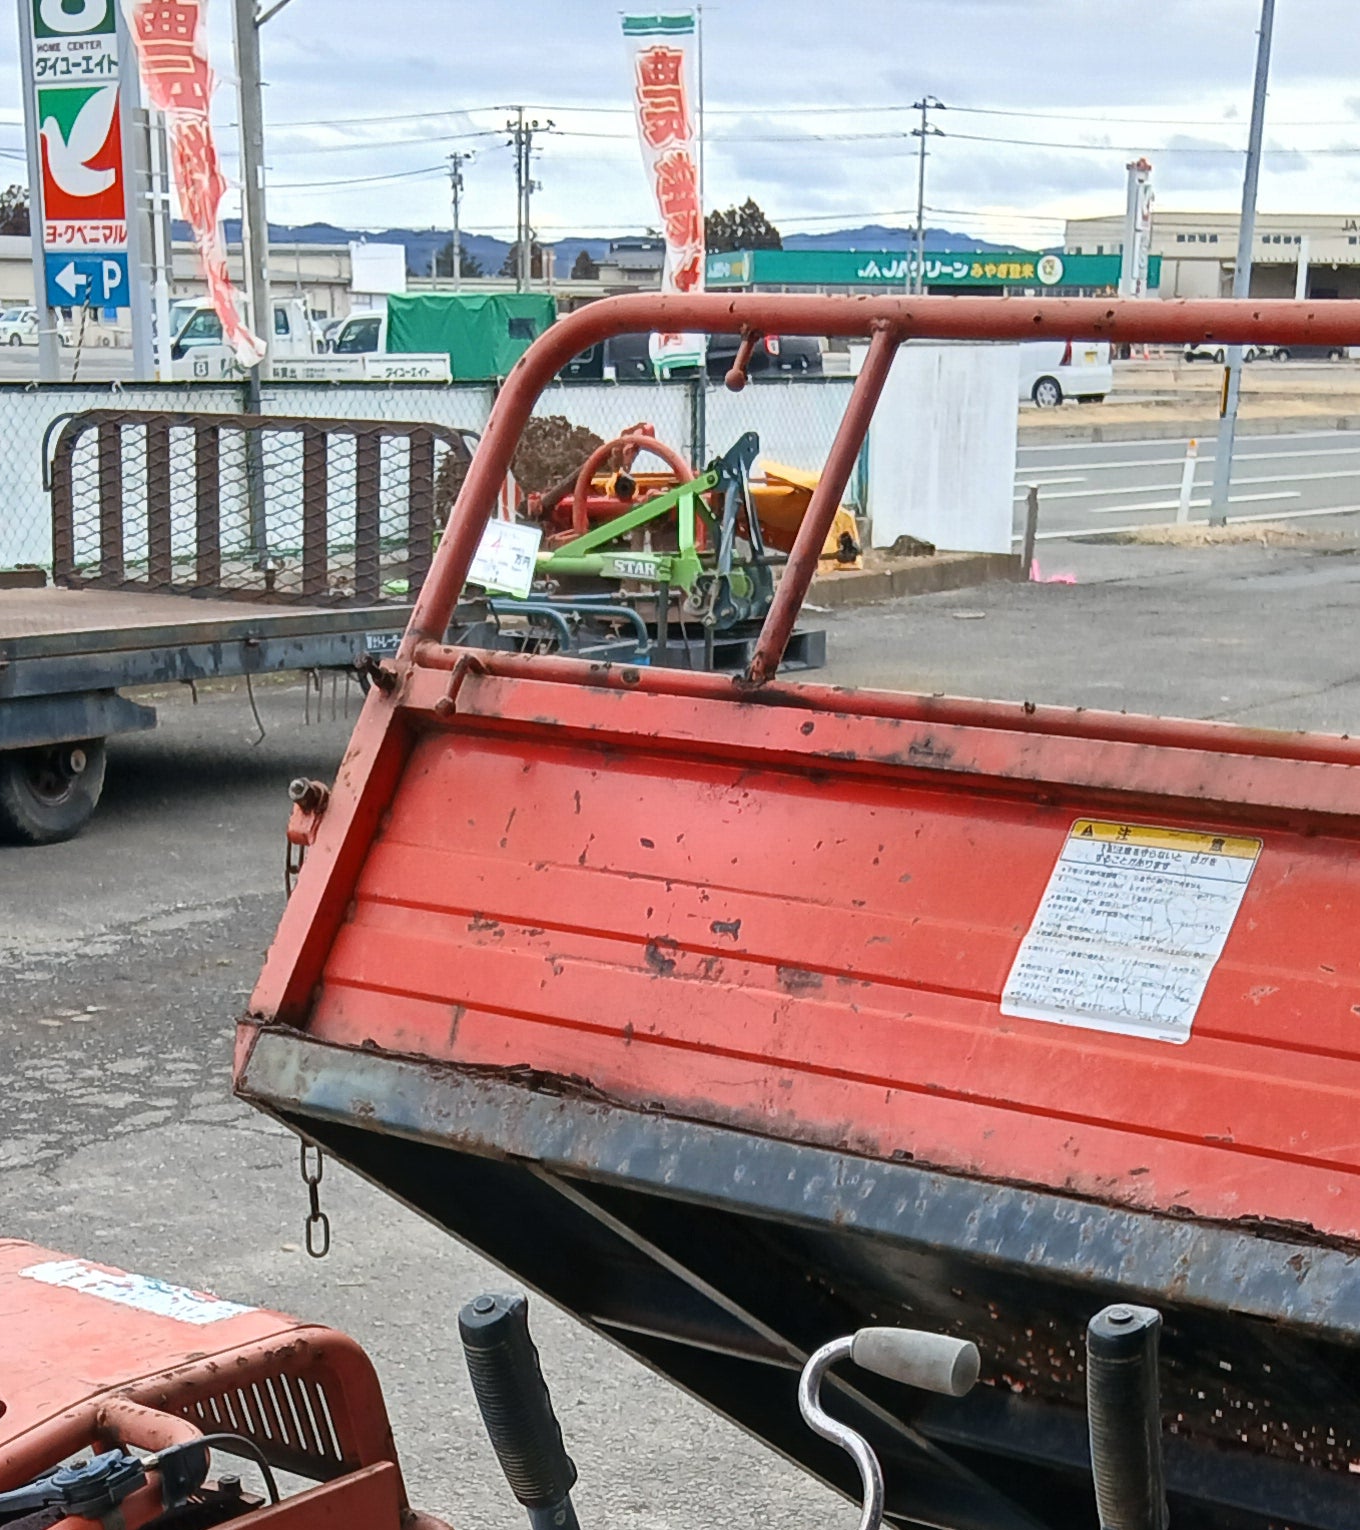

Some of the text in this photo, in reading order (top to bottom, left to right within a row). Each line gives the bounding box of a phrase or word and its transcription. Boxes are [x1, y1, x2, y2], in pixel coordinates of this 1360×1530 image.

[37, 40, 101, 52] HOME CENTER
[36, 53, 119, 76] ダイユーエイト
[102, 260, 122, 299] P
[614, 559, 656, 576] STAR
